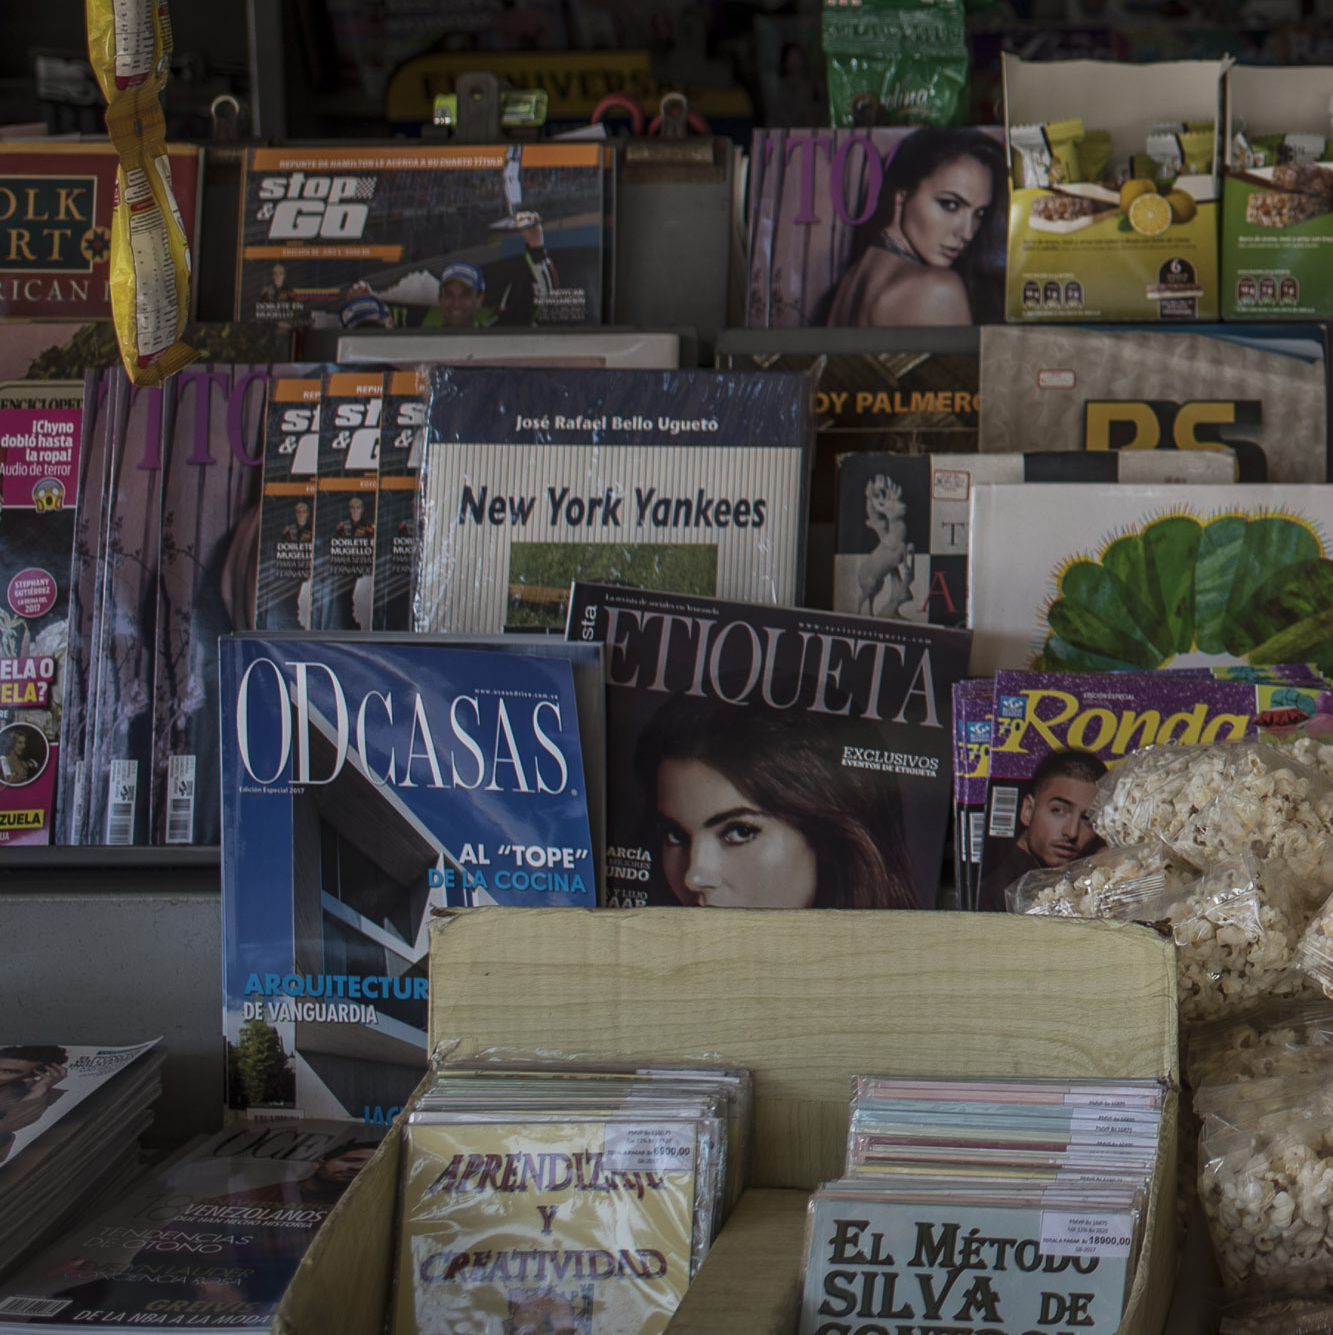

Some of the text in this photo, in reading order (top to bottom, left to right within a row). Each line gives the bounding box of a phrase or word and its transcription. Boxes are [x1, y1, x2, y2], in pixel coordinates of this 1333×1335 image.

[516, 415, 718, 435] José Rafael Bello Ugueto
[459, 487, 766, 528] New York Yankees
[604, 606, 943, 728] ETIQUETA
[237, 658, 568, 796] OD CASAS
[843, 746, 939, 769] EXCLUSIVOS
[459, 844, 490, 865] AL
[428, 869, 586, 892] DE LA COCINA
[243, 1003, 379, 1024] DE VANGUARDIA
[538, 1205, 558, 1235] Y
[1089, 1236, 1130, 1246] 18900,00
[420, 1249, 667, 1283] CREATIVIDAD
[818, 1270, 1003, 1322] SILVA
